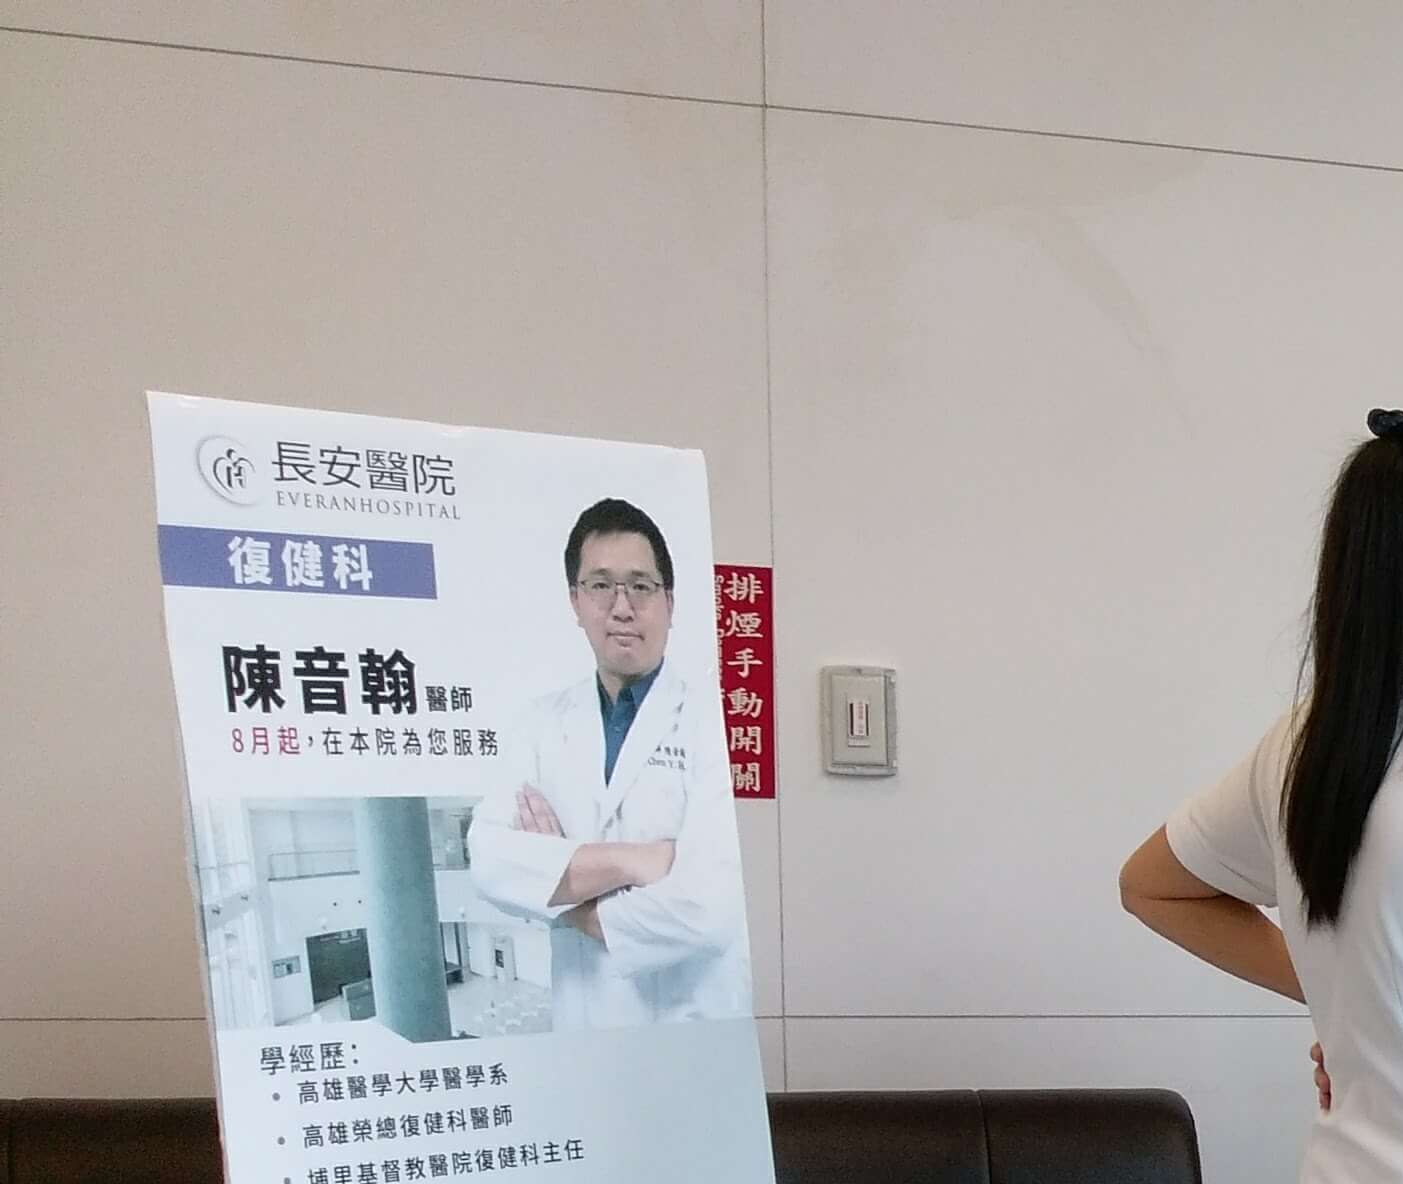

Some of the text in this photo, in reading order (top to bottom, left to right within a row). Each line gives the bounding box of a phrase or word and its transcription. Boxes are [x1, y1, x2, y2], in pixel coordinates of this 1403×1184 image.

[272, 442, 456, 496] 長安醫院
[276, 491, 461, 520] EVERANHOSPITAL
[228, 536, 373, 590] 復健科
[298, 1062, 509, 1105] 高雄醫學大學醫學系
[303, 1104, 514, 1149] 高雄榮總復健科醫師
